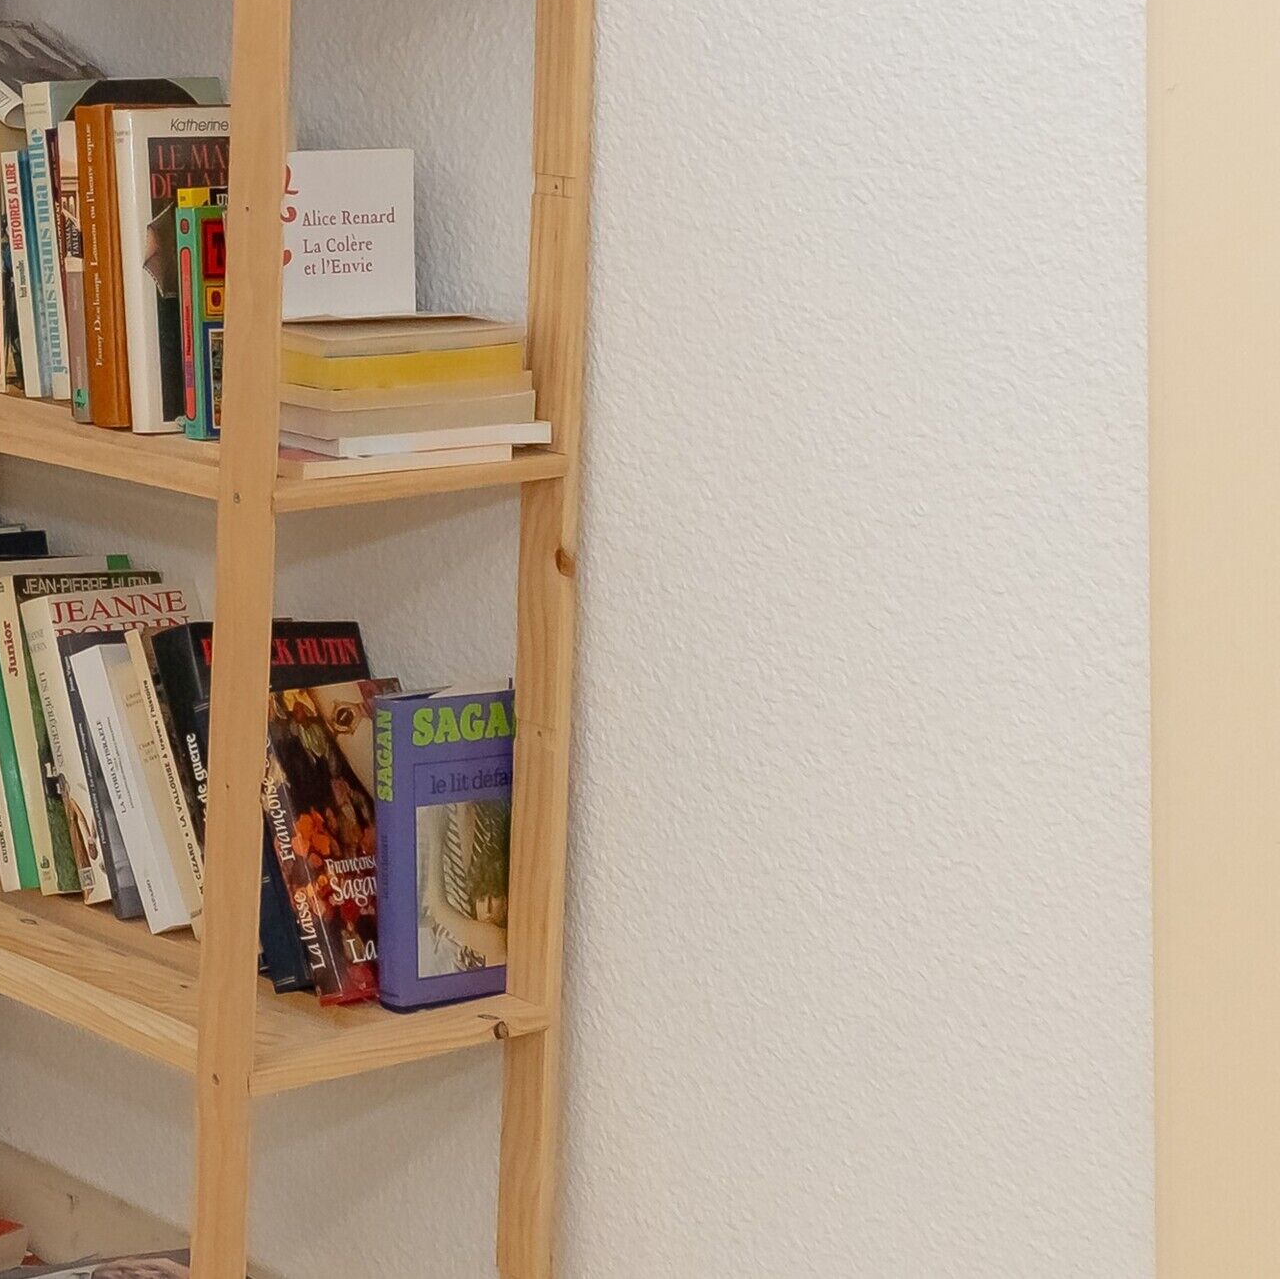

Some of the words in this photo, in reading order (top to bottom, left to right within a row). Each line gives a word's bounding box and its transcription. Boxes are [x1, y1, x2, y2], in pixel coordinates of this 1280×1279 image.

[170, 118, 229, 132] Katherine
[27, 128, 47, 177] fille
[158, 145, 185, 171] LE
[5, 163, 17, 184] LIRE
[85, 166, 96, 202] l'heure
[151, 174, 172, 199] DE
[8, 187, 18, 195] A
[33, 186, 50, 223] ma
[8, 198, 24, 251] HISTOIRES
[88, 206, 96, 219] ou
[302, 208, 336, 227] Alice
[341, 207, 395, 225] Renard
[38, 229, 54, 285] sans
[87, 224, 98, 267] Louison
[303, 238, 322, 254] La
[325, 234, 373, 253] Colère
[304, 262, 316, 276] et
[321, 257, 373, 275] l'Envie
[89, 272, 101, 331] Deschamps
[43, 290, 67, 375] jamais
[93, 335, 104, 367] Fanny
[51, 590, 187, 624] JEANNE
[1, 620, 19, 677] Junior
[296, 637, 360, 665] HUTIN
[38, 671, 50, 693] LES
[141, 680, 159, 717] l'histoire
[151, 718, 166, 750] travers
[412, 701, 514, 746] SAGA
[183, 733, 205, 781] guerre
[377, 710, 393, 802] SAGAN
[107, 767, 124, 798] STORIA
[164, 762, 185, 812] VALLOUISE
[194, 784, 208, 803] de
[431, 775, 446, 795] le
[449, 773, 468, 793] lit
[117, 799, 128, 813] LA
[179, 814, 188, 828] LA
[263, 776, 296, 861] Françoise
[184, 842, 202, 879] CÉZARD
[293, 891, 322, 939] laisse
[310, 942, 327, 969] La
[347, 937, 378, 963] La
